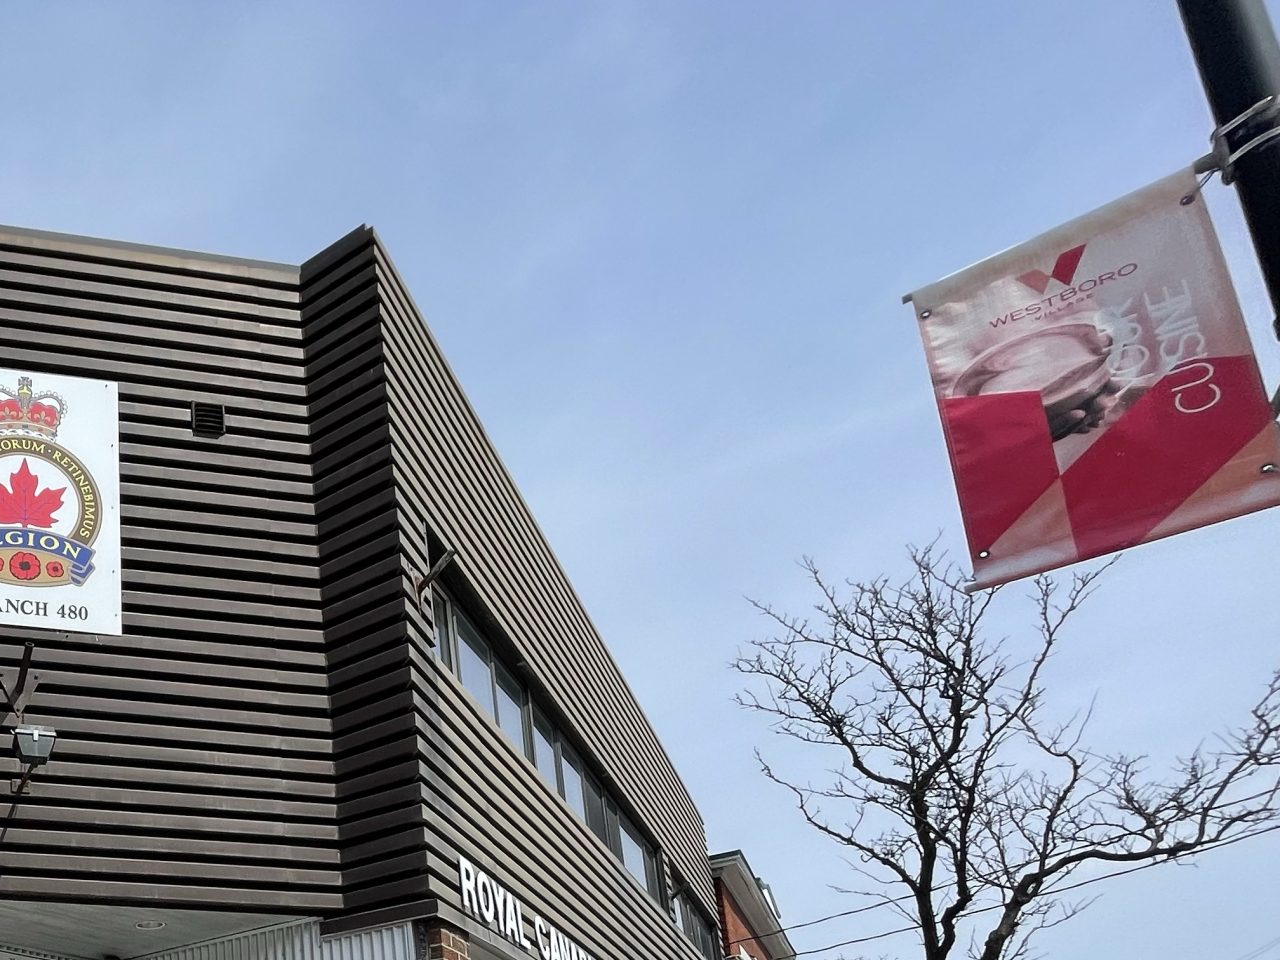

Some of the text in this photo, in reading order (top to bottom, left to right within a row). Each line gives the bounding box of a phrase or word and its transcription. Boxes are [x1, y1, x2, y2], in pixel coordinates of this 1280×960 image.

[989, 262, 1138, 328] WESTBORO
[51, 450, 96, 539] RETINEBIMUS
[56, 604, 88, 621] 480
[458, 855, 531, 950] ROYAL
